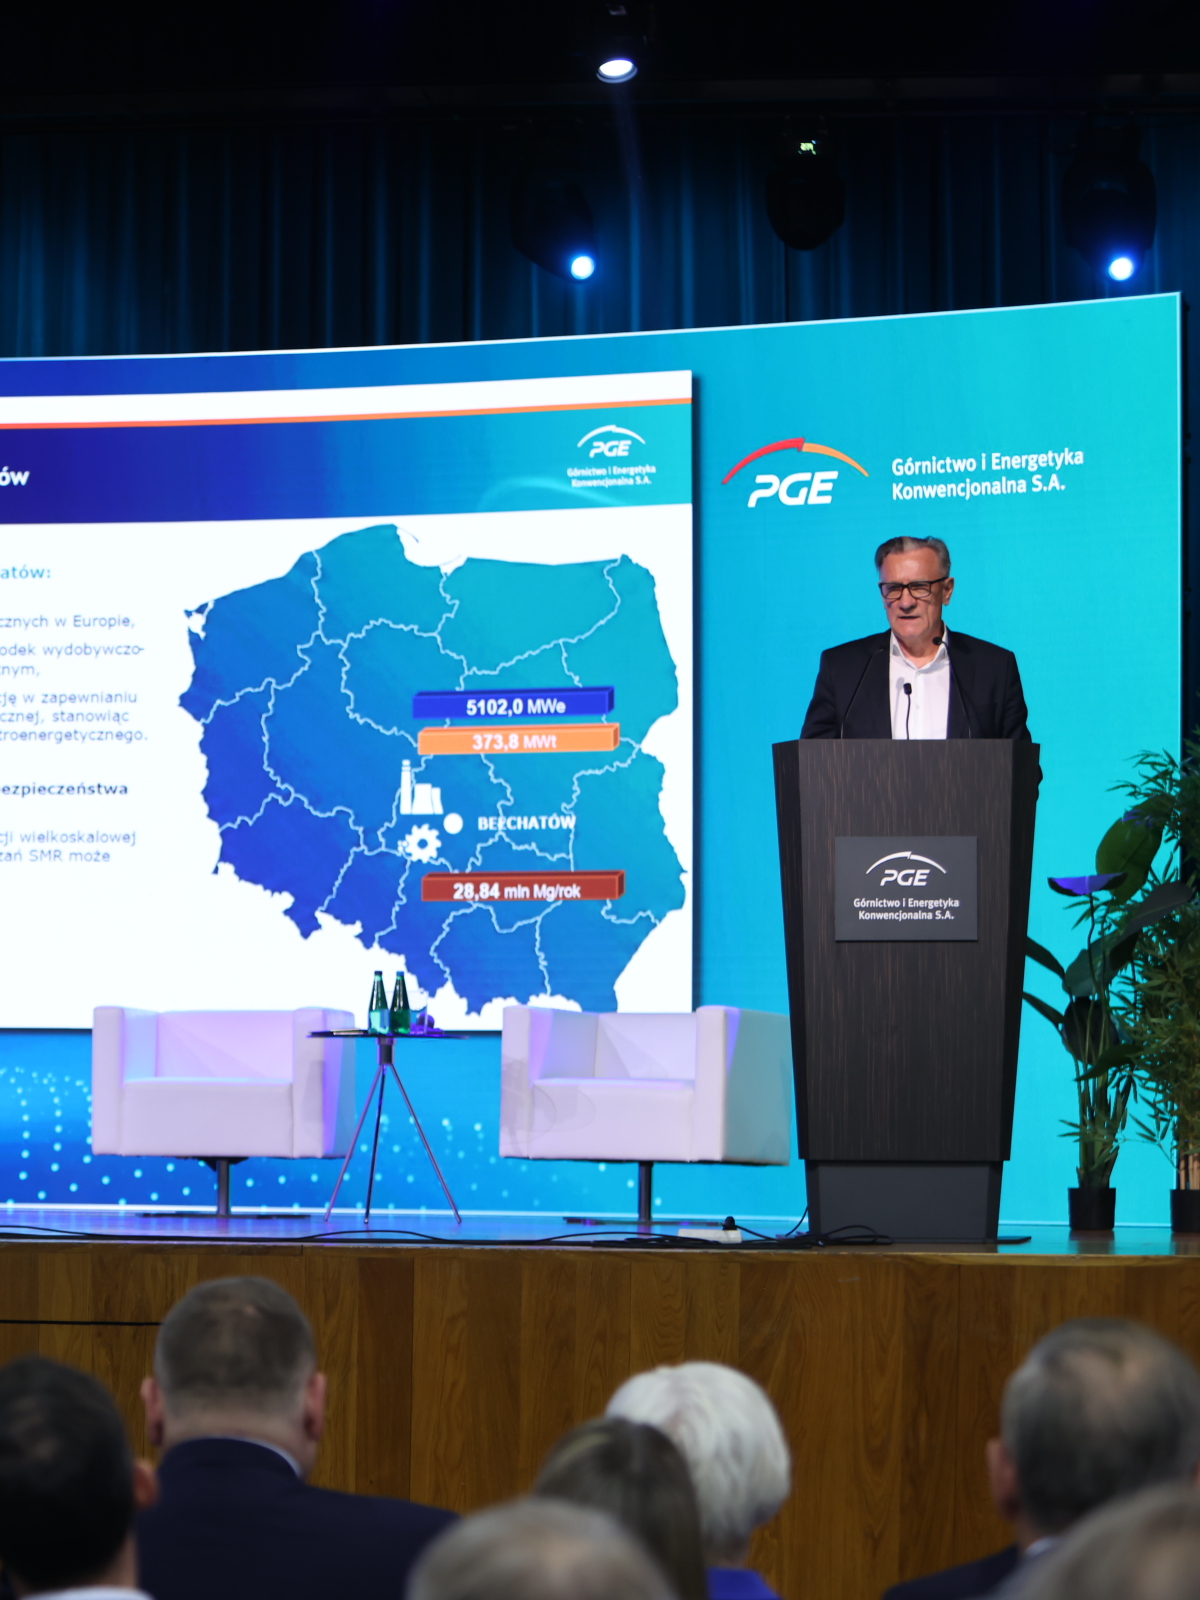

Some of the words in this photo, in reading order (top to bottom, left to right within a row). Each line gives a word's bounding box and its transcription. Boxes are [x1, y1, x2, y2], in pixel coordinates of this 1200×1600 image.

[588, 439, 633, 459] PGE
[891, 455, 978, 477] Górnictwo
[991, 447, 1085, 472] Energetyka
[748, 471, 839, 507] PGE
[892, 475, 1028, 501] Konwencjonalna
[1031, 473, 1067, 493] S.A.
[72, 614, 135, 630] Europie,
[42, 642, 145, 659] wydobywczo-
[40, 691, 138, 707] zapewnianiu
[466, 697, 524, 718] 5102,0
[527, 697, 567, 714] MWe
[51, 709, 130, 726] stanowiąc
[471, 733, 520, 752] 373,8
[522, 733, 558, 750] MWt
[477, 811, 577, 832] BEŁCHATÓW
[19, 829, 137, 847] wielkoskalowej
[28, 848, 63, 863] SMR
[68, 849, 111, 863] może
[879, 868, 931, 887] PGE
[452, 882, 501, 901] 28,84
[503, 883, 531, 900] mln
[533, 882, 582, 902] Mg/rok
[853, 897, 901, 908] Górnictwo
[907, 897, 960, 910] Energetyka
[858, 909, 934, 922] Konwencjonalna
[934, 909, 955, 920] S.A.
